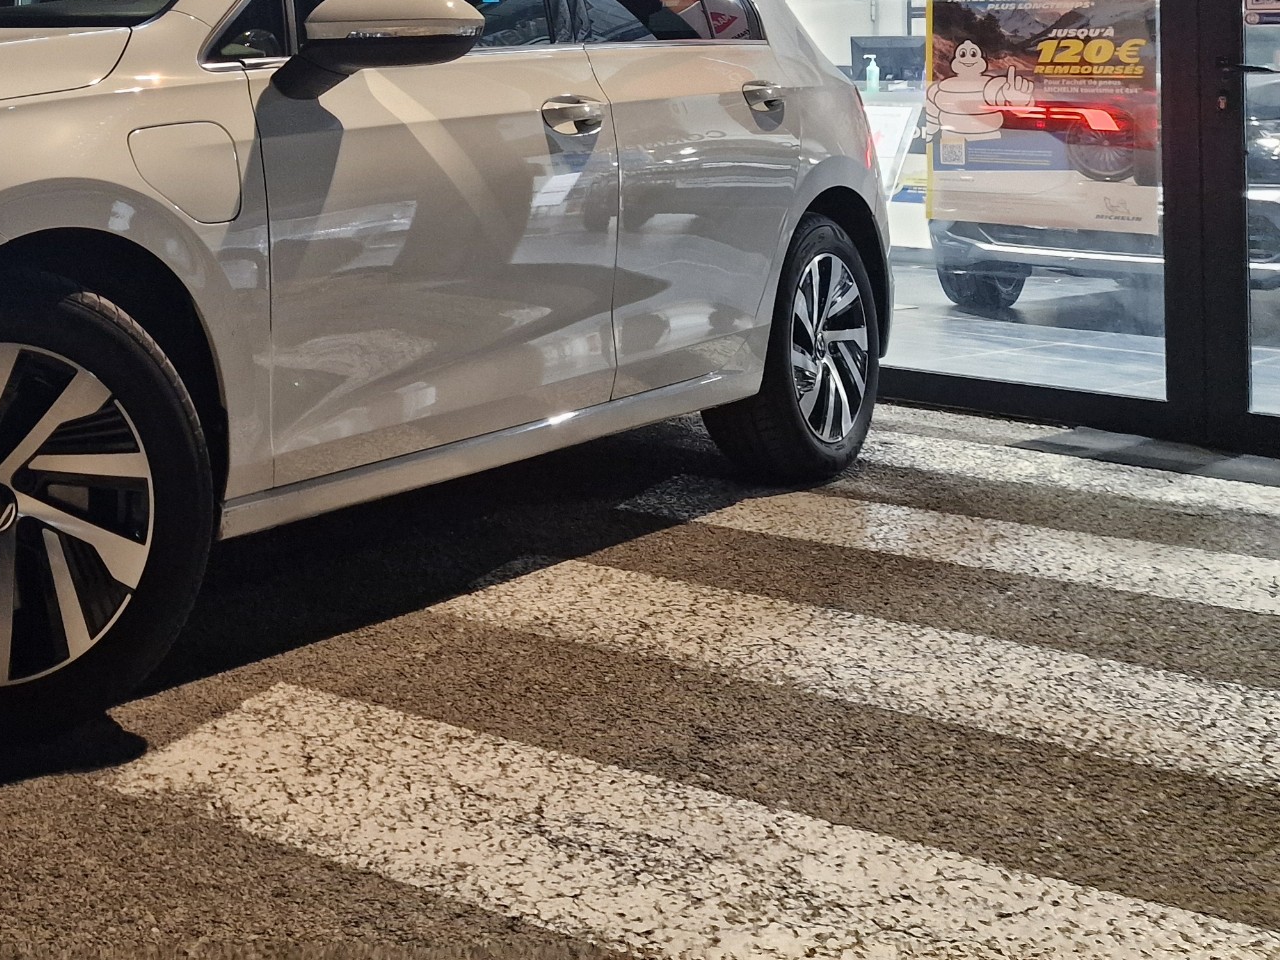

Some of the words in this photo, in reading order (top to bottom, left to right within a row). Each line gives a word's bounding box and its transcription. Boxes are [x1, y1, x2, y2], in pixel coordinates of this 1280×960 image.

[1048, 26, 1115, 39] JUSQU'À
[1035, 38, 1147, 64] 120€
[1034, 63, 1145, 75] REMBOURSÉS
[1095, 214, 1142, 222] MICHELIN
